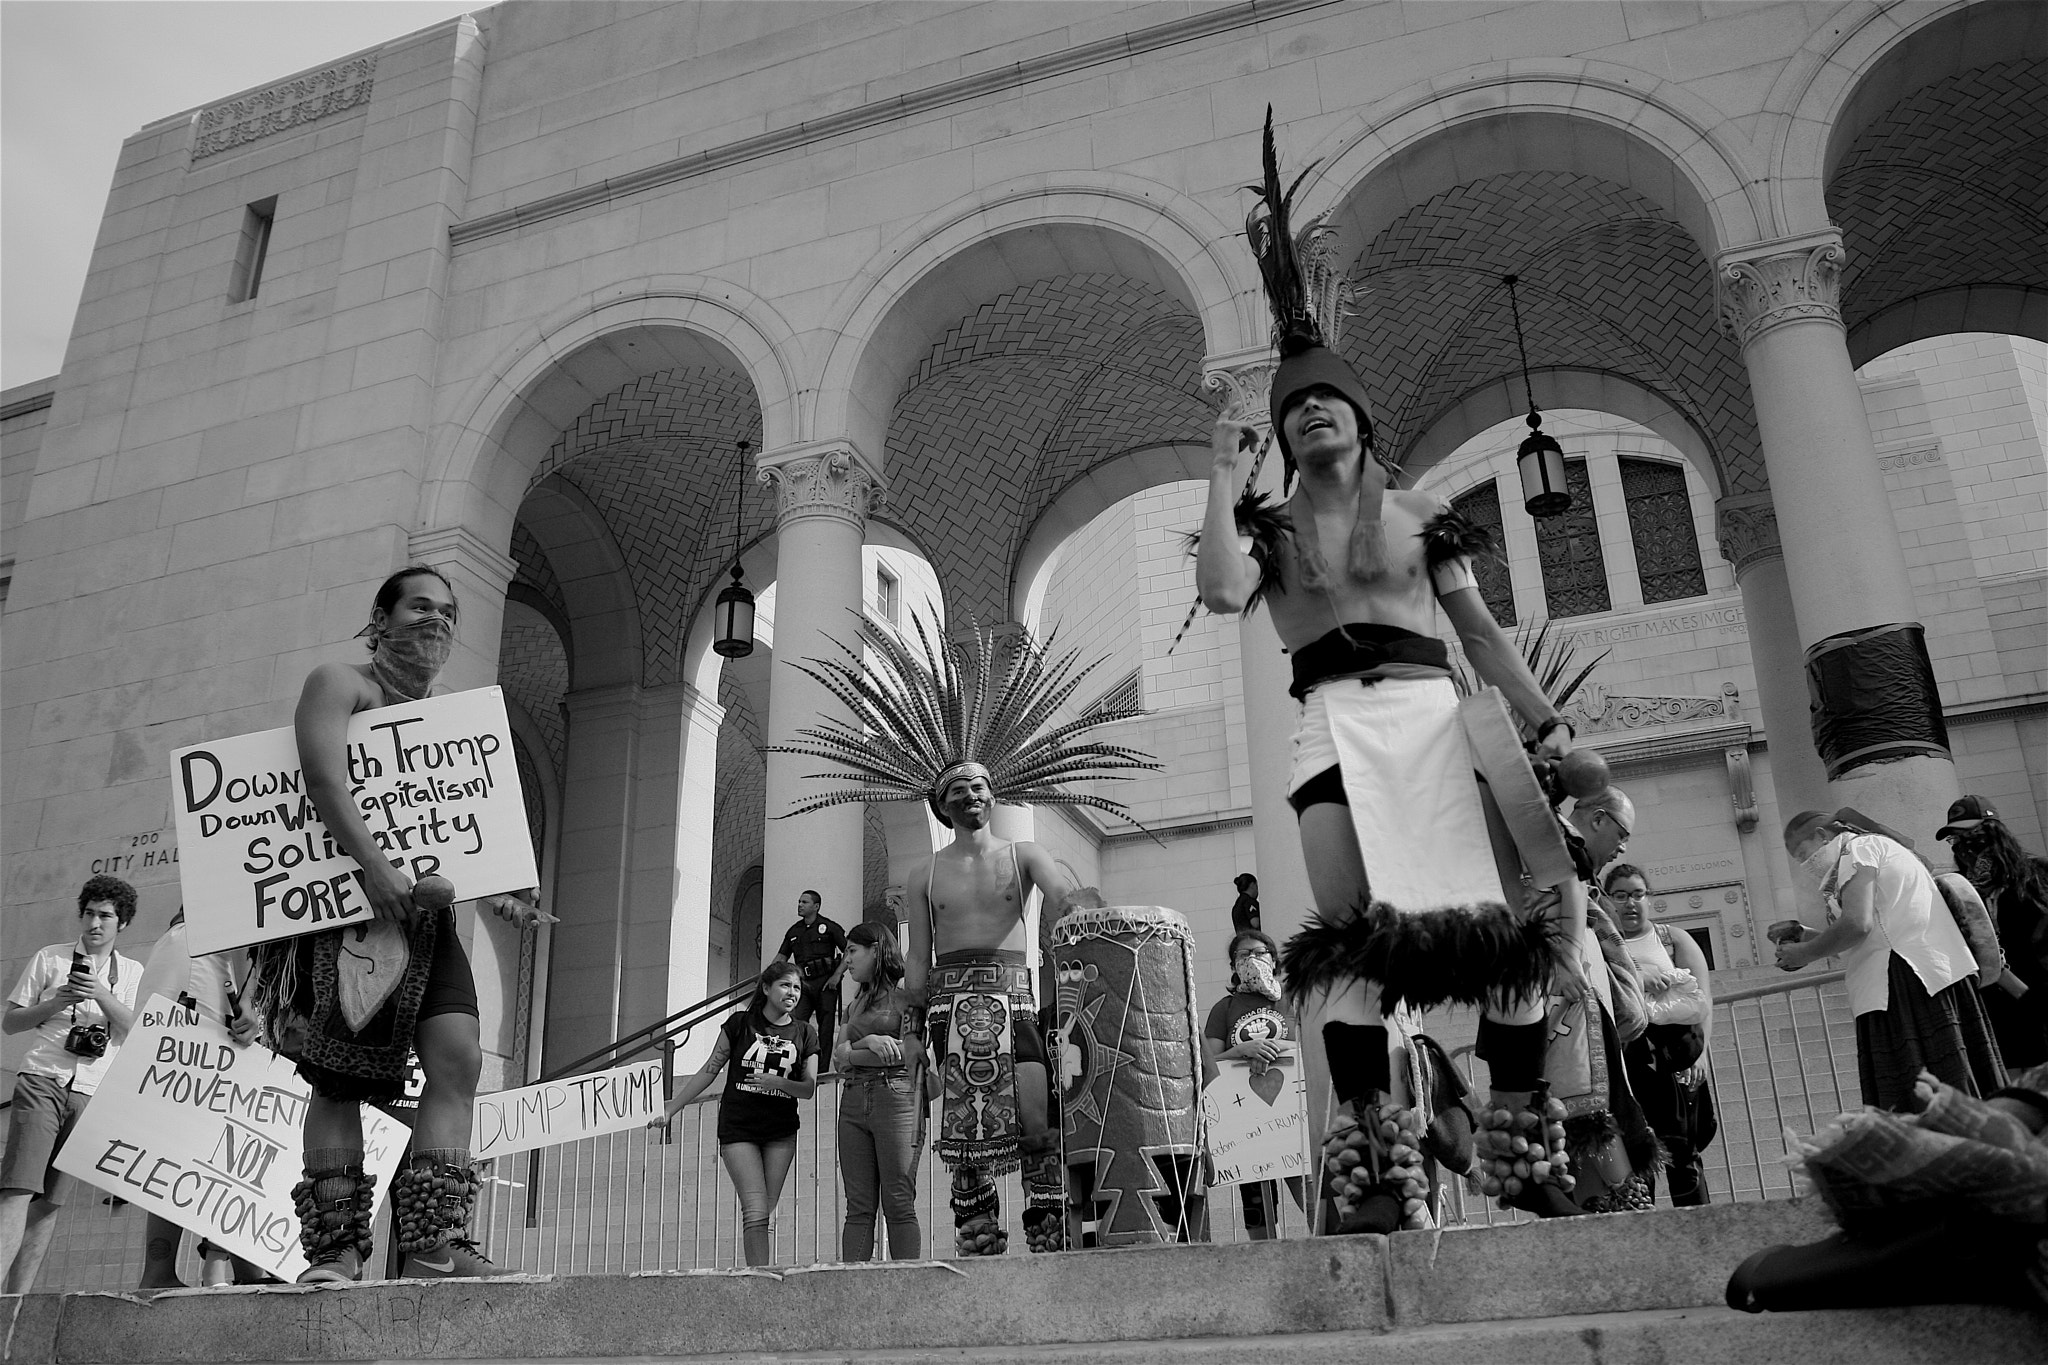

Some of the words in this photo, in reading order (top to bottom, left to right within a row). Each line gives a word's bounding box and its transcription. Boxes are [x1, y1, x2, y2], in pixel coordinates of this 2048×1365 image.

[1594, 623, 1643, 645] RIGHT
[1645, 614, 1699, 636] MAKES
[1704, 608, 1744, 626] MIGH
[1720, 625, 1747, 635] LINCO
[347, 743, 382, 785] th
[370, 717, 500, 788] Trump
[132, 832, 159, 847] 200
[91, 854, 135, 875] CITY
[143, 847, 179, 867] HAL
[1690, 857, 1734, 872] SOLOMON
[253, 855, 441, 929] FORER
[156, 1035, 236, 1072] BUILD
[479, 1085, 567, 1153] DUMP
[567, 1065, 662, 1131] TRUMP
[1246, 1125, 1262, 1140] and
[1264, 1109, 1309, 1132] TRUMP
[207, 1122, 280, 1190] NOT
